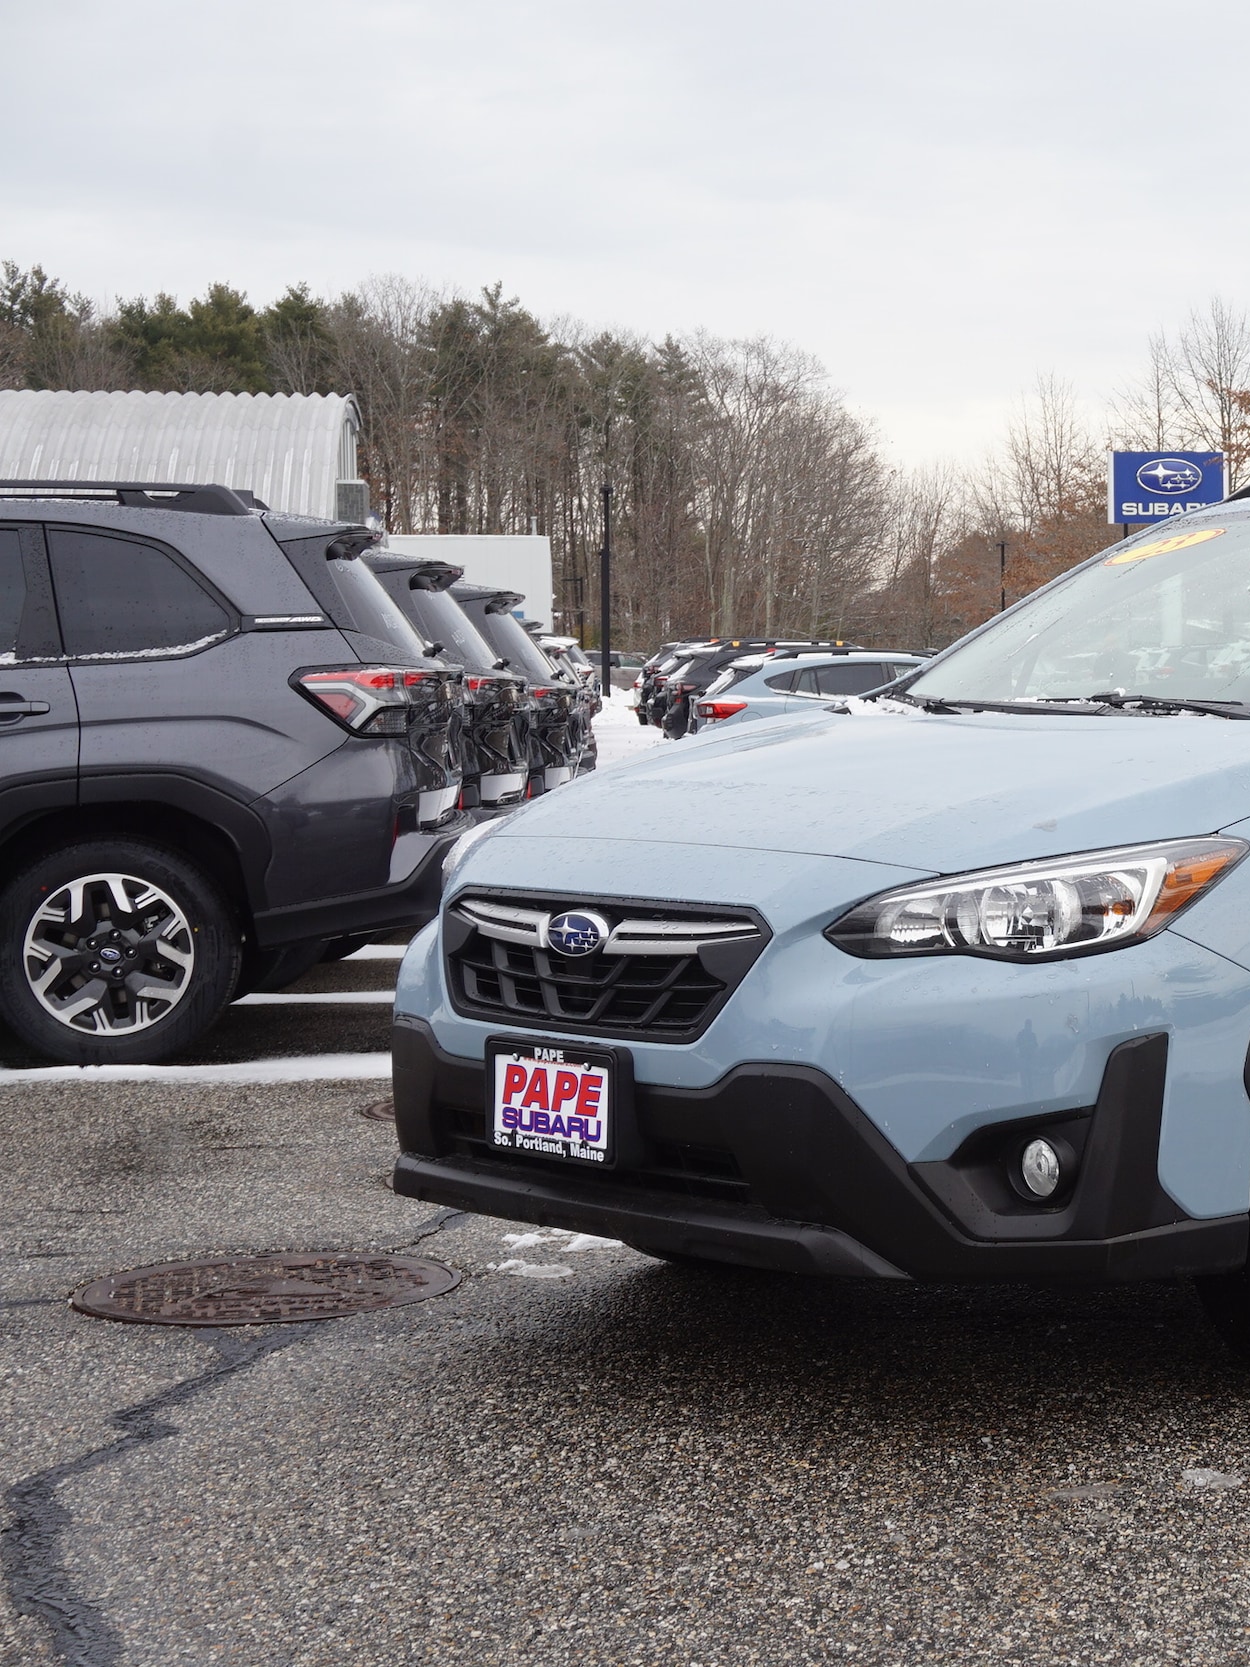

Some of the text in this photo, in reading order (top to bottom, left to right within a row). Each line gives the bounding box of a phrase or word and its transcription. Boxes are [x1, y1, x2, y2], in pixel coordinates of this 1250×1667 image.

[1121, 502, 1207, 516] SUBAR
[533, 1047, 565, 1063] PAPE
[502, 1063, 603, 1118] PAPE
[501, 1106, 601, 1143] SUBARU
[493, 1131, 512, 1147] So.
[515, 1134, 566, 1158] Portland,
[569, 1142, 605, 1163] Maine
